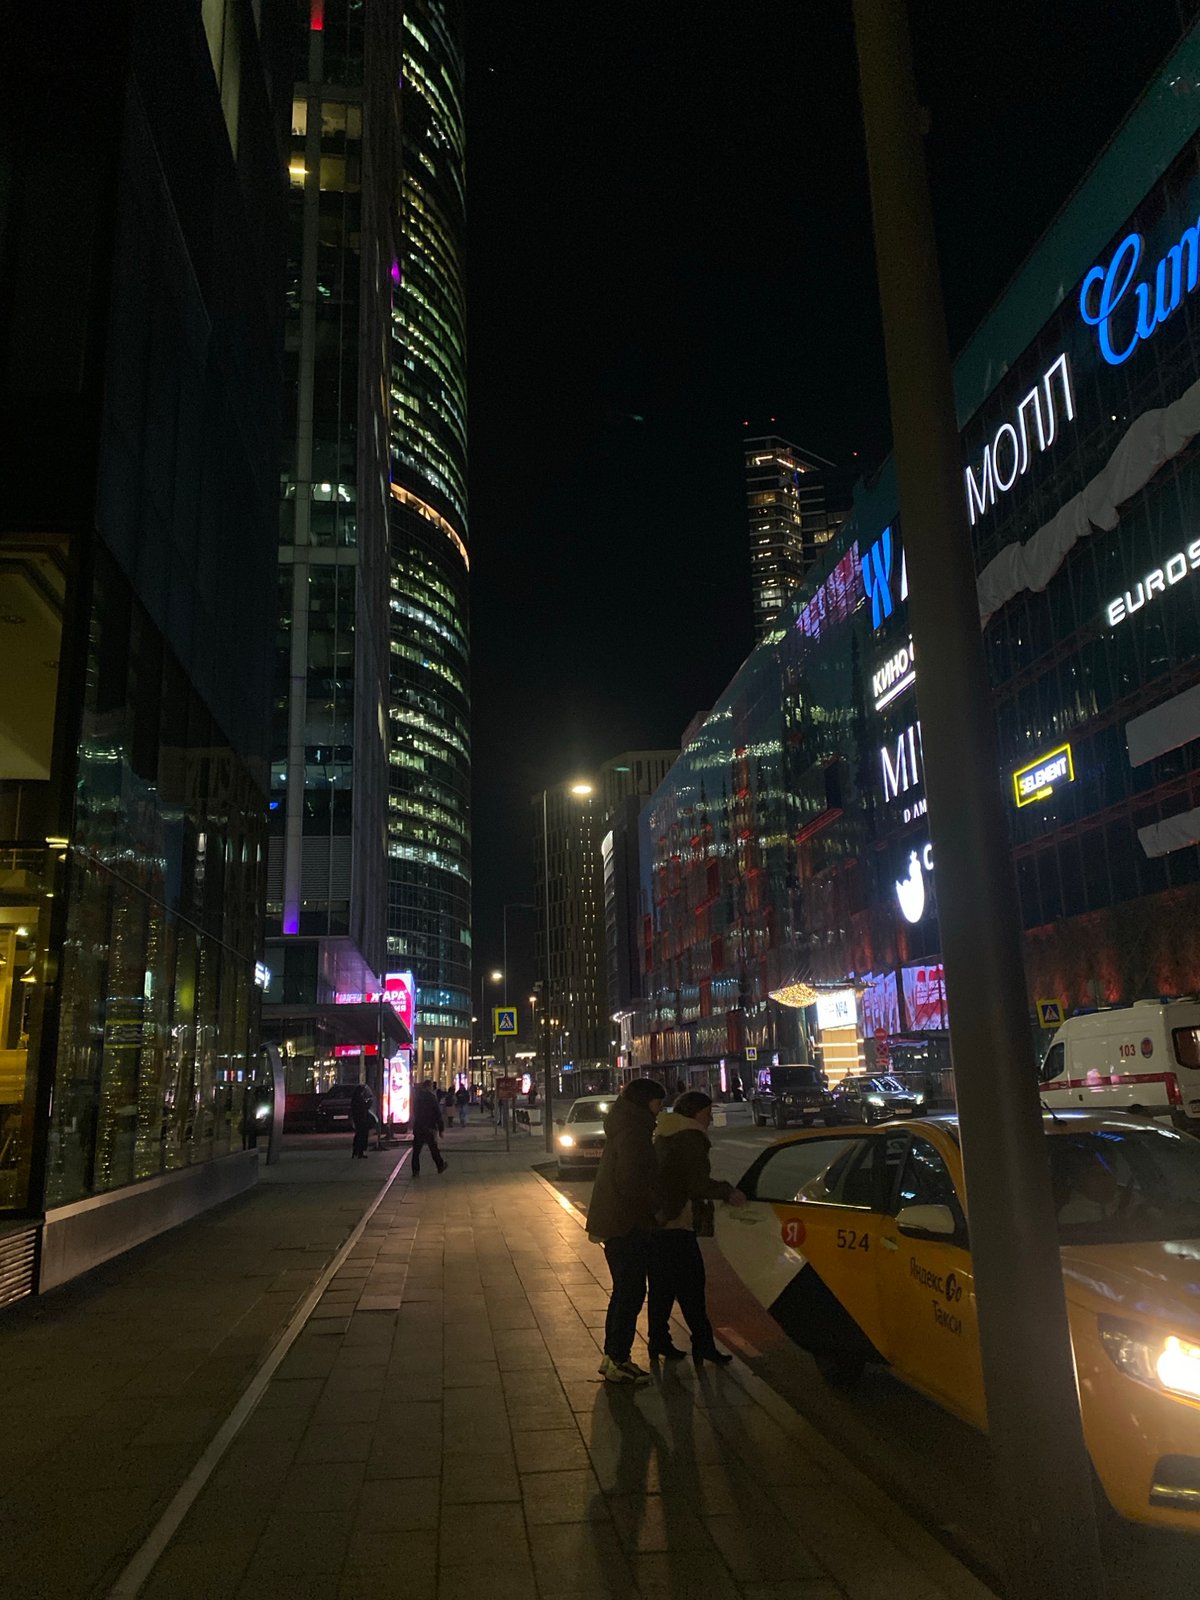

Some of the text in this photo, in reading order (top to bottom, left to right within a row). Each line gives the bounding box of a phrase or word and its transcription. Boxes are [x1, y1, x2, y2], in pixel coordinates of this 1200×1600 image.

[880, 720, 924, 803] MI
[1119, 1045, 1136, 1057] 103
[786, 1222, 798, 1242] Я
[837, 1229, 869, 1252] 524
[910, 1256, 945, 1294] Яндекс
[931, 1299, 962, 1335] Такси
